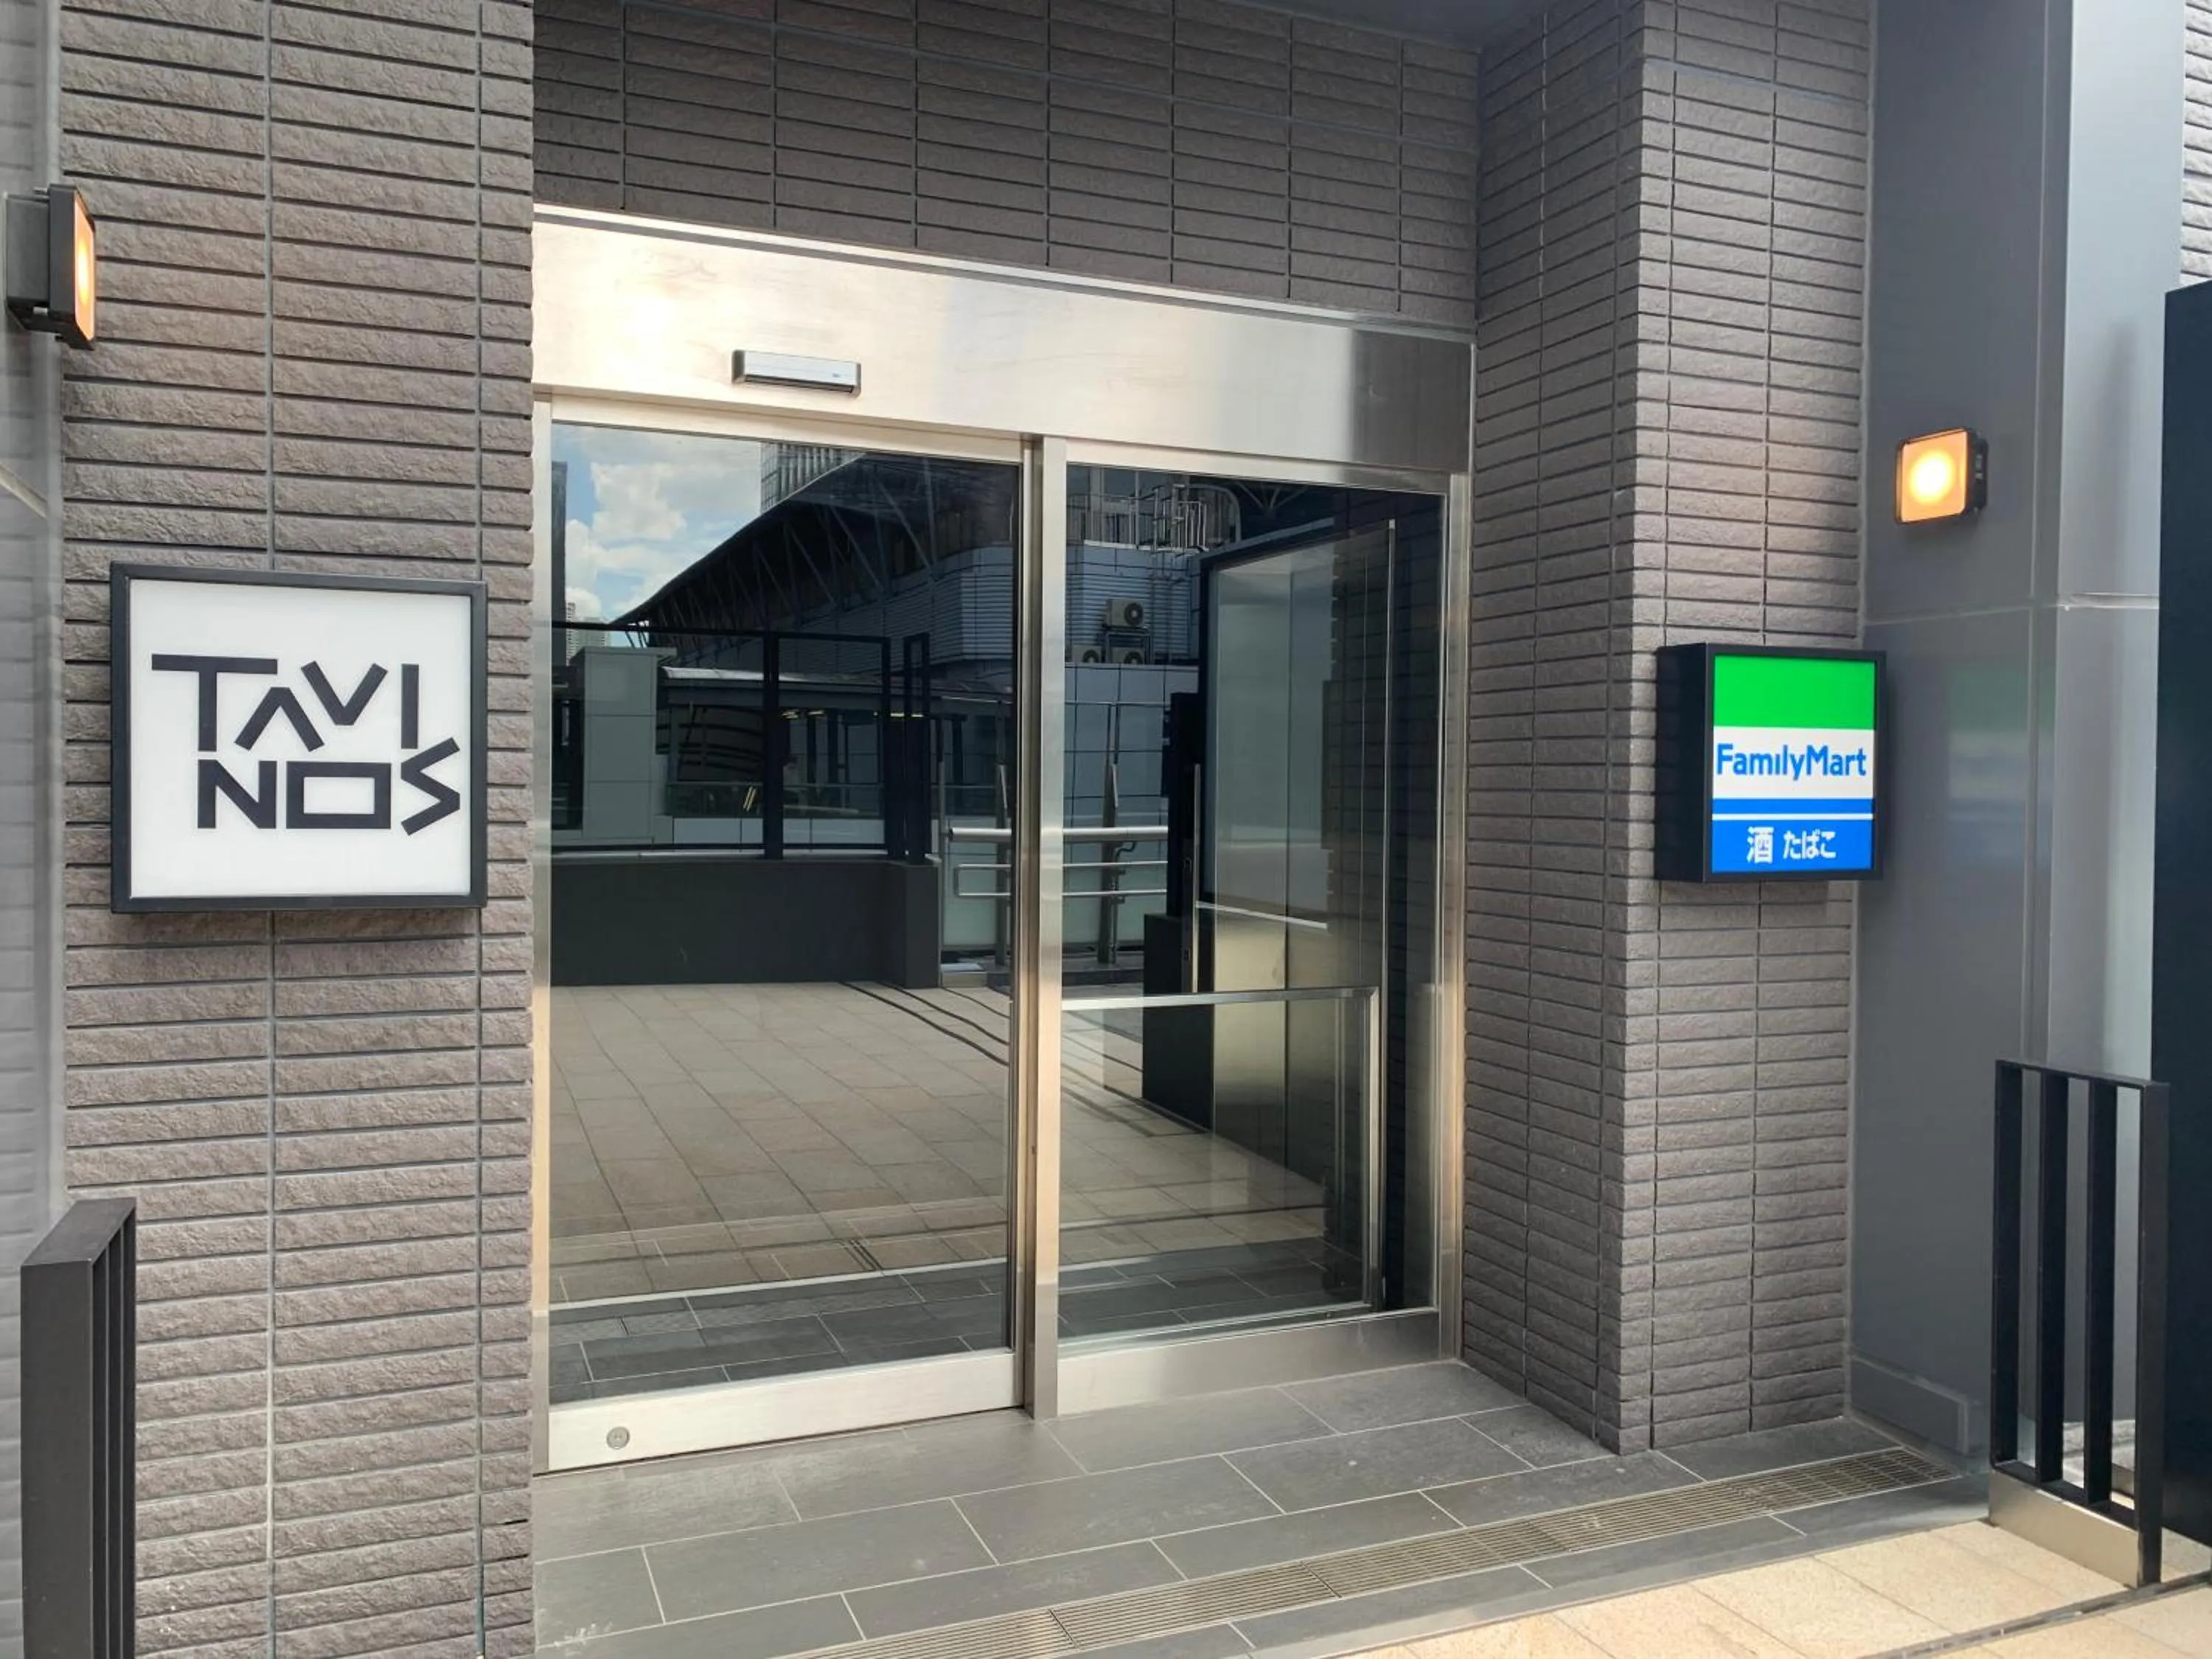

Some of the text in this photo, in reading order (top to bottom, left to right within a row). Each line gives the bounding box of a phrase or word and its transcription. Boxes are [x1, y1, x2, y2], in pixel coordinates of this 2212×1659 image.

[152, 653, 419, 752] TAVI
[198, 737, 460, 835] NOS
[1717, 744, 1866, 781] FamilyMart
[1747, 826, 1836, 863] 酒 たばこ
